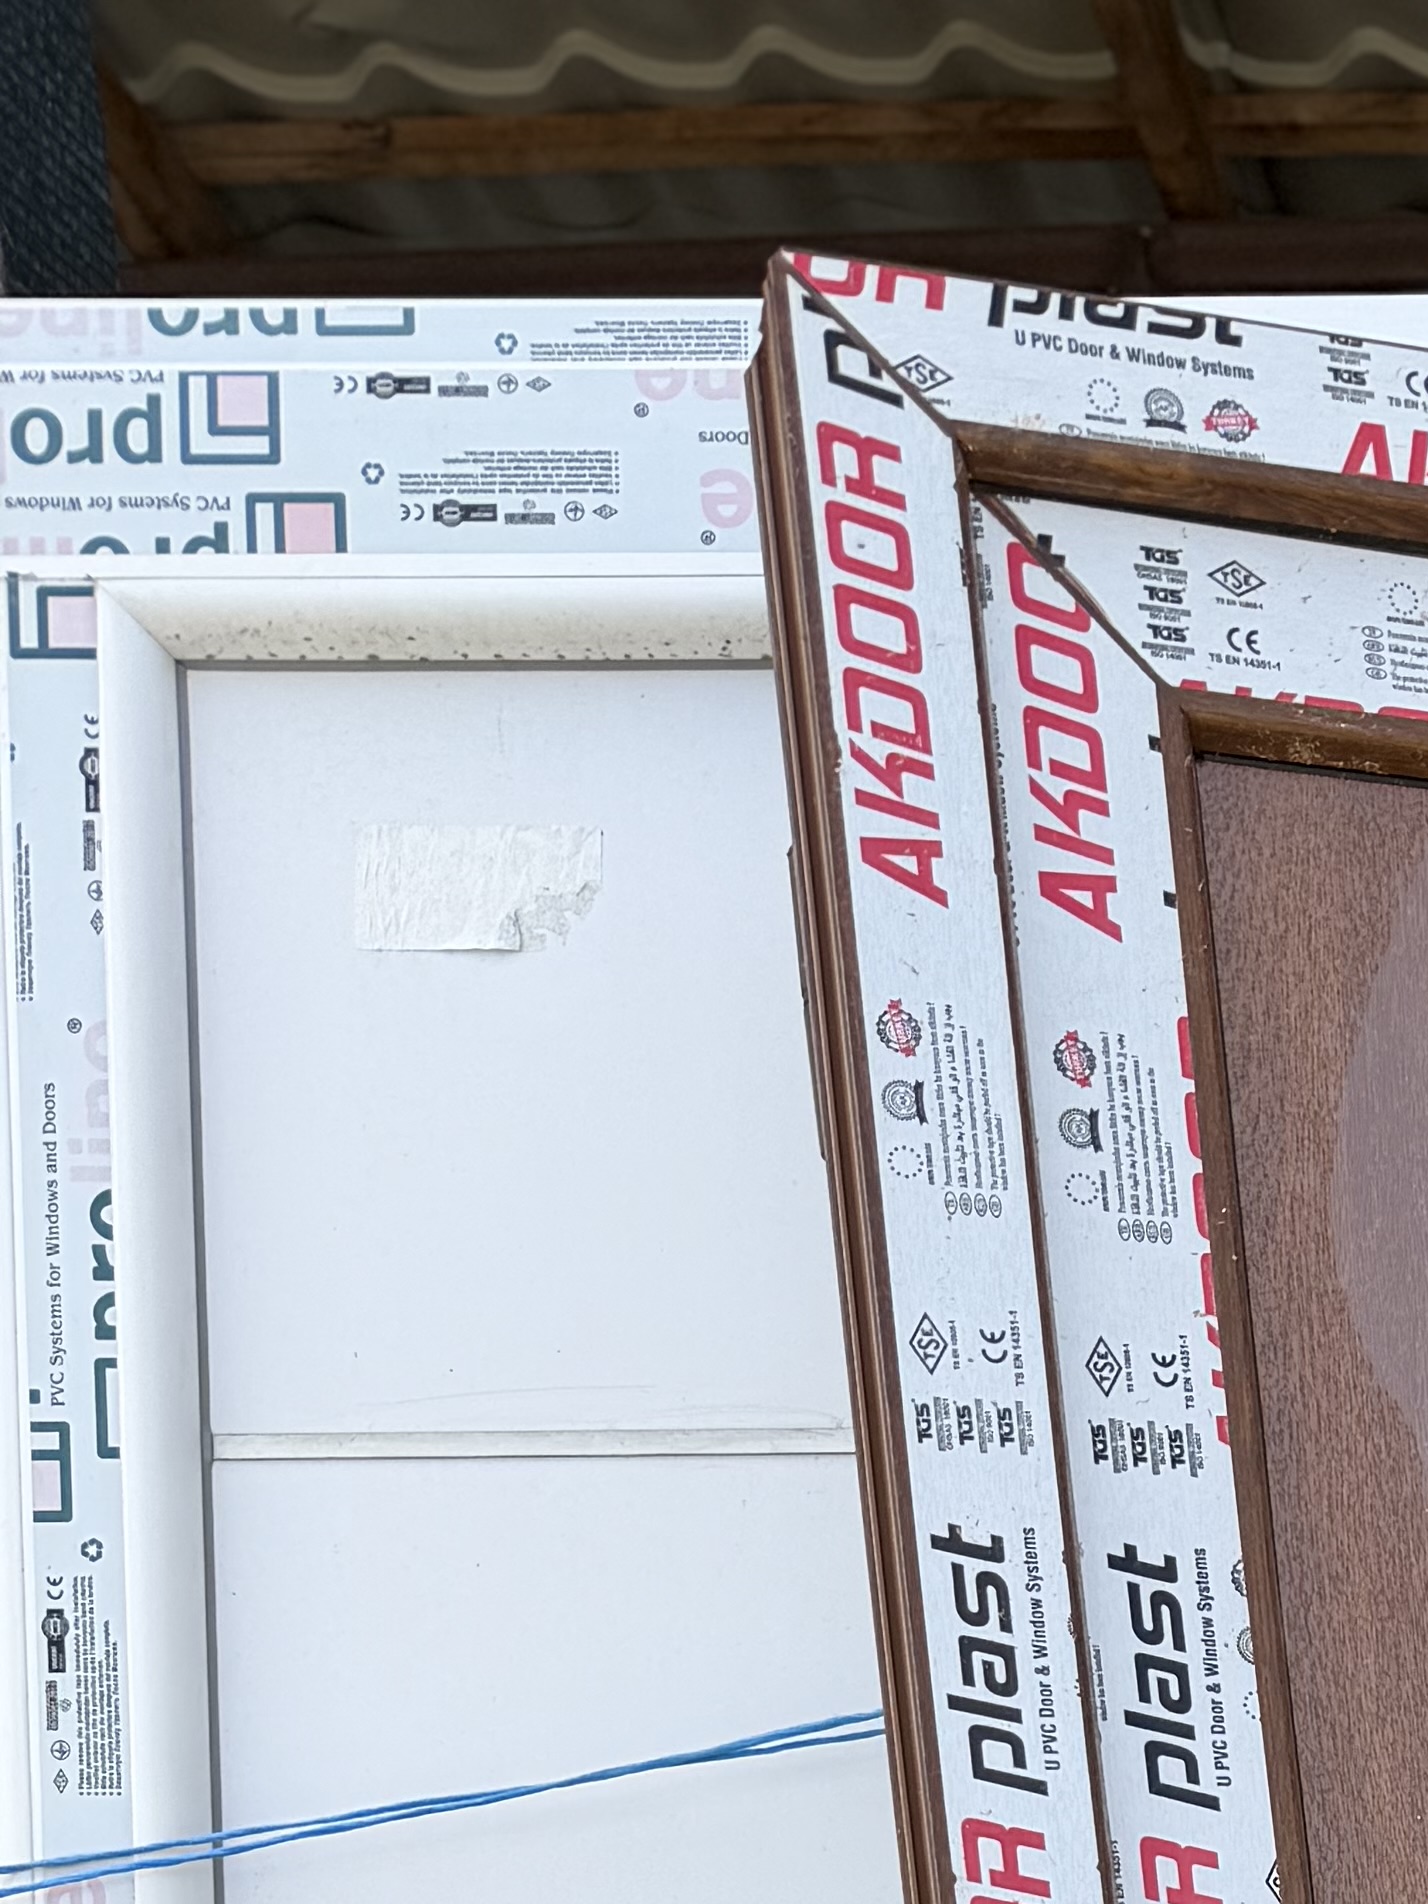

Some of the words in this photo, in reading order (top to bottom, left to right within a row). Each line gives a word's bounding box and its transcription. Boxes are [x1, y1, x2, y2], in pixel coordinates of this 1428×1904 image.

[1014, 329, 1025, 346] U
[1030, 332, 1062, 351] PVC
[1067, 337, 1104, 357] Door
[1109, 344, 1120, 359] &
[1125, 346, 1186, 369] Window
[1191, 356, 1254, 380] Systems
[4, 496, 81, 511] Windows
[87, 496, 112, 511] for
[118, 492, 190, 510] Systems
[196, 495, 230, 510] PVC
[1226, 627, 1260, 655] CE
[817, 422, 948, 907] AKDOOR
[42, 1082, 56, 1133] Doors
[42, 1140, 57, 1173] and
[44, 1179, 59, 1256] Windows
[46, 1262, 60, 1287] for
[49, 1293, 66, 1365] Systems
[978, 1328, 1007, 1363] CE
[49, 1371, 65, 1405] PVC
[1022, 1527, 1043, 1592] Systems
[1029, 1597, 1048, 1658] Window
[931, 1523, 1049, 1796] plast
[1034, 1665, 1050, 1675] &
[1106, 1543, 1221, 1812] plast
[1038, 1680, 1054, 1717] Door
[1040, 1723, 1058, 1753] PVC
[1044, 1759, 1060, 1770] U
